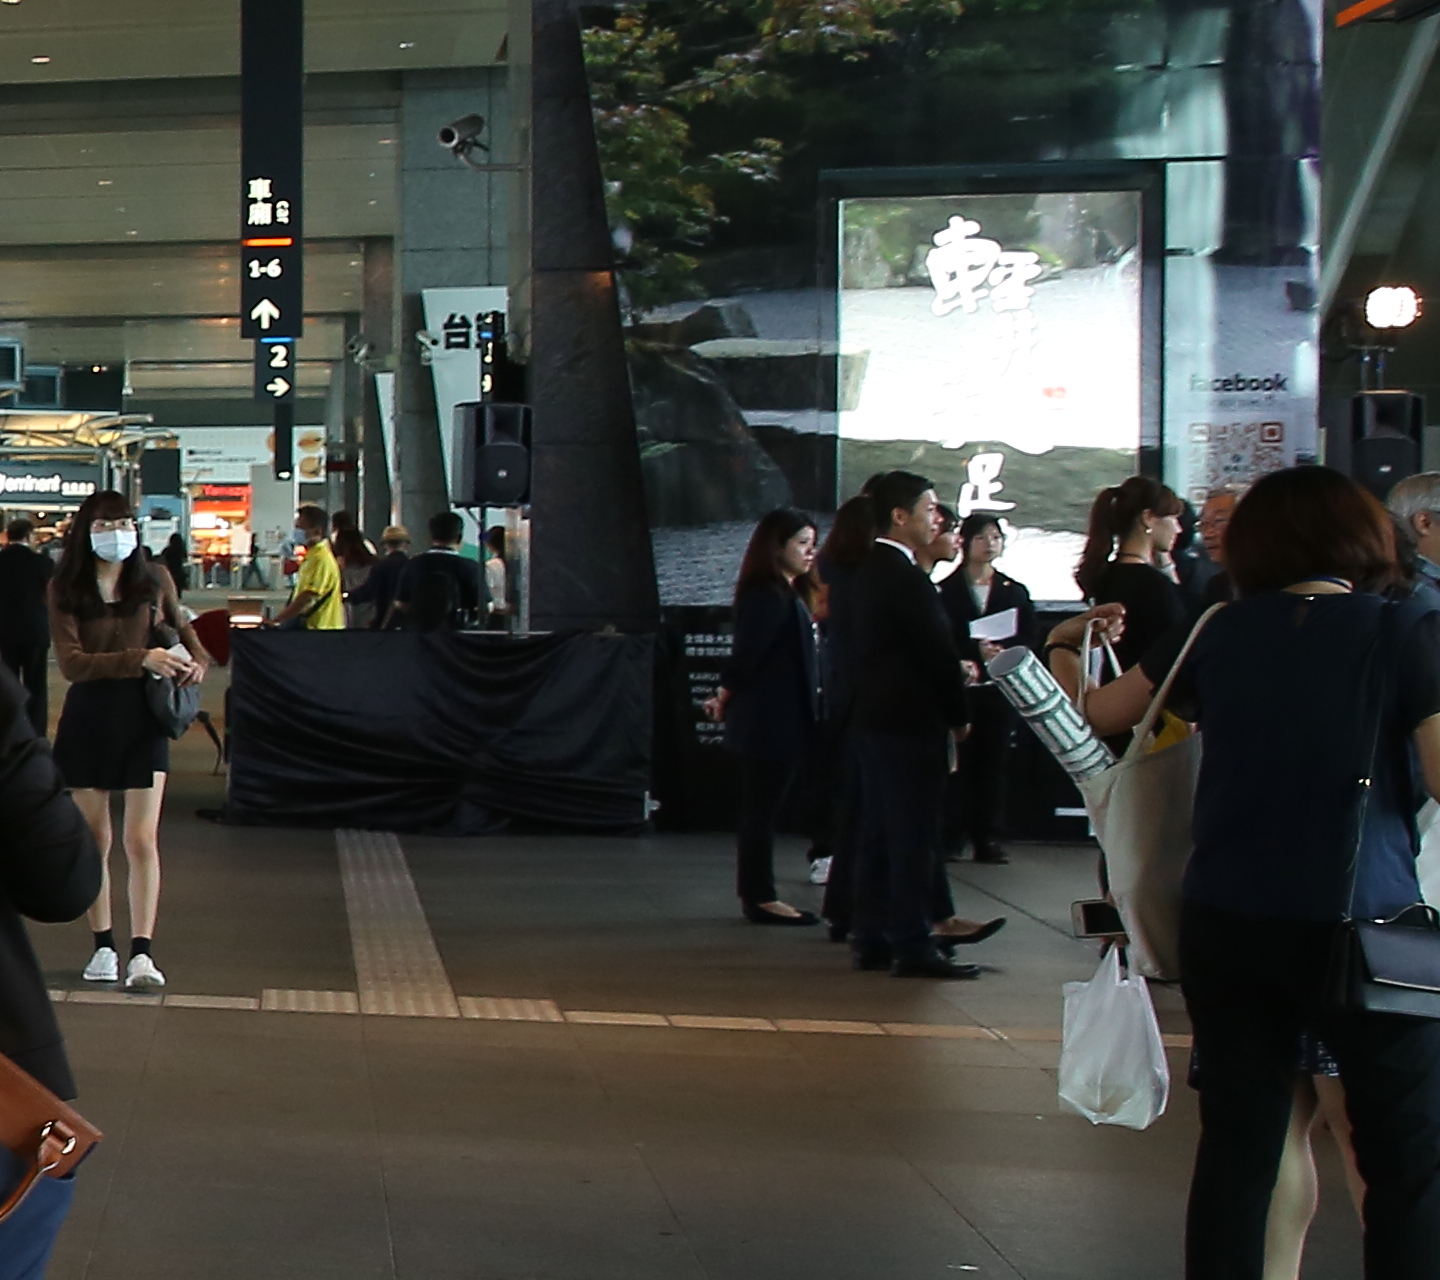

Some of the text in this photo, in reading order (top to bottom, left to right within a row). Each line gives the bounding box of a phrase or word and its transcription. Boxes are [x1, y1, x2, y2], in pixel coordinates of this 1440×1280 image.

[247, 177, 273, 226] 車廂
[248, 258, 282, 279] 1-6
[268, 345, 289, 369] 2
[5, 473, 63, 494] eminent
